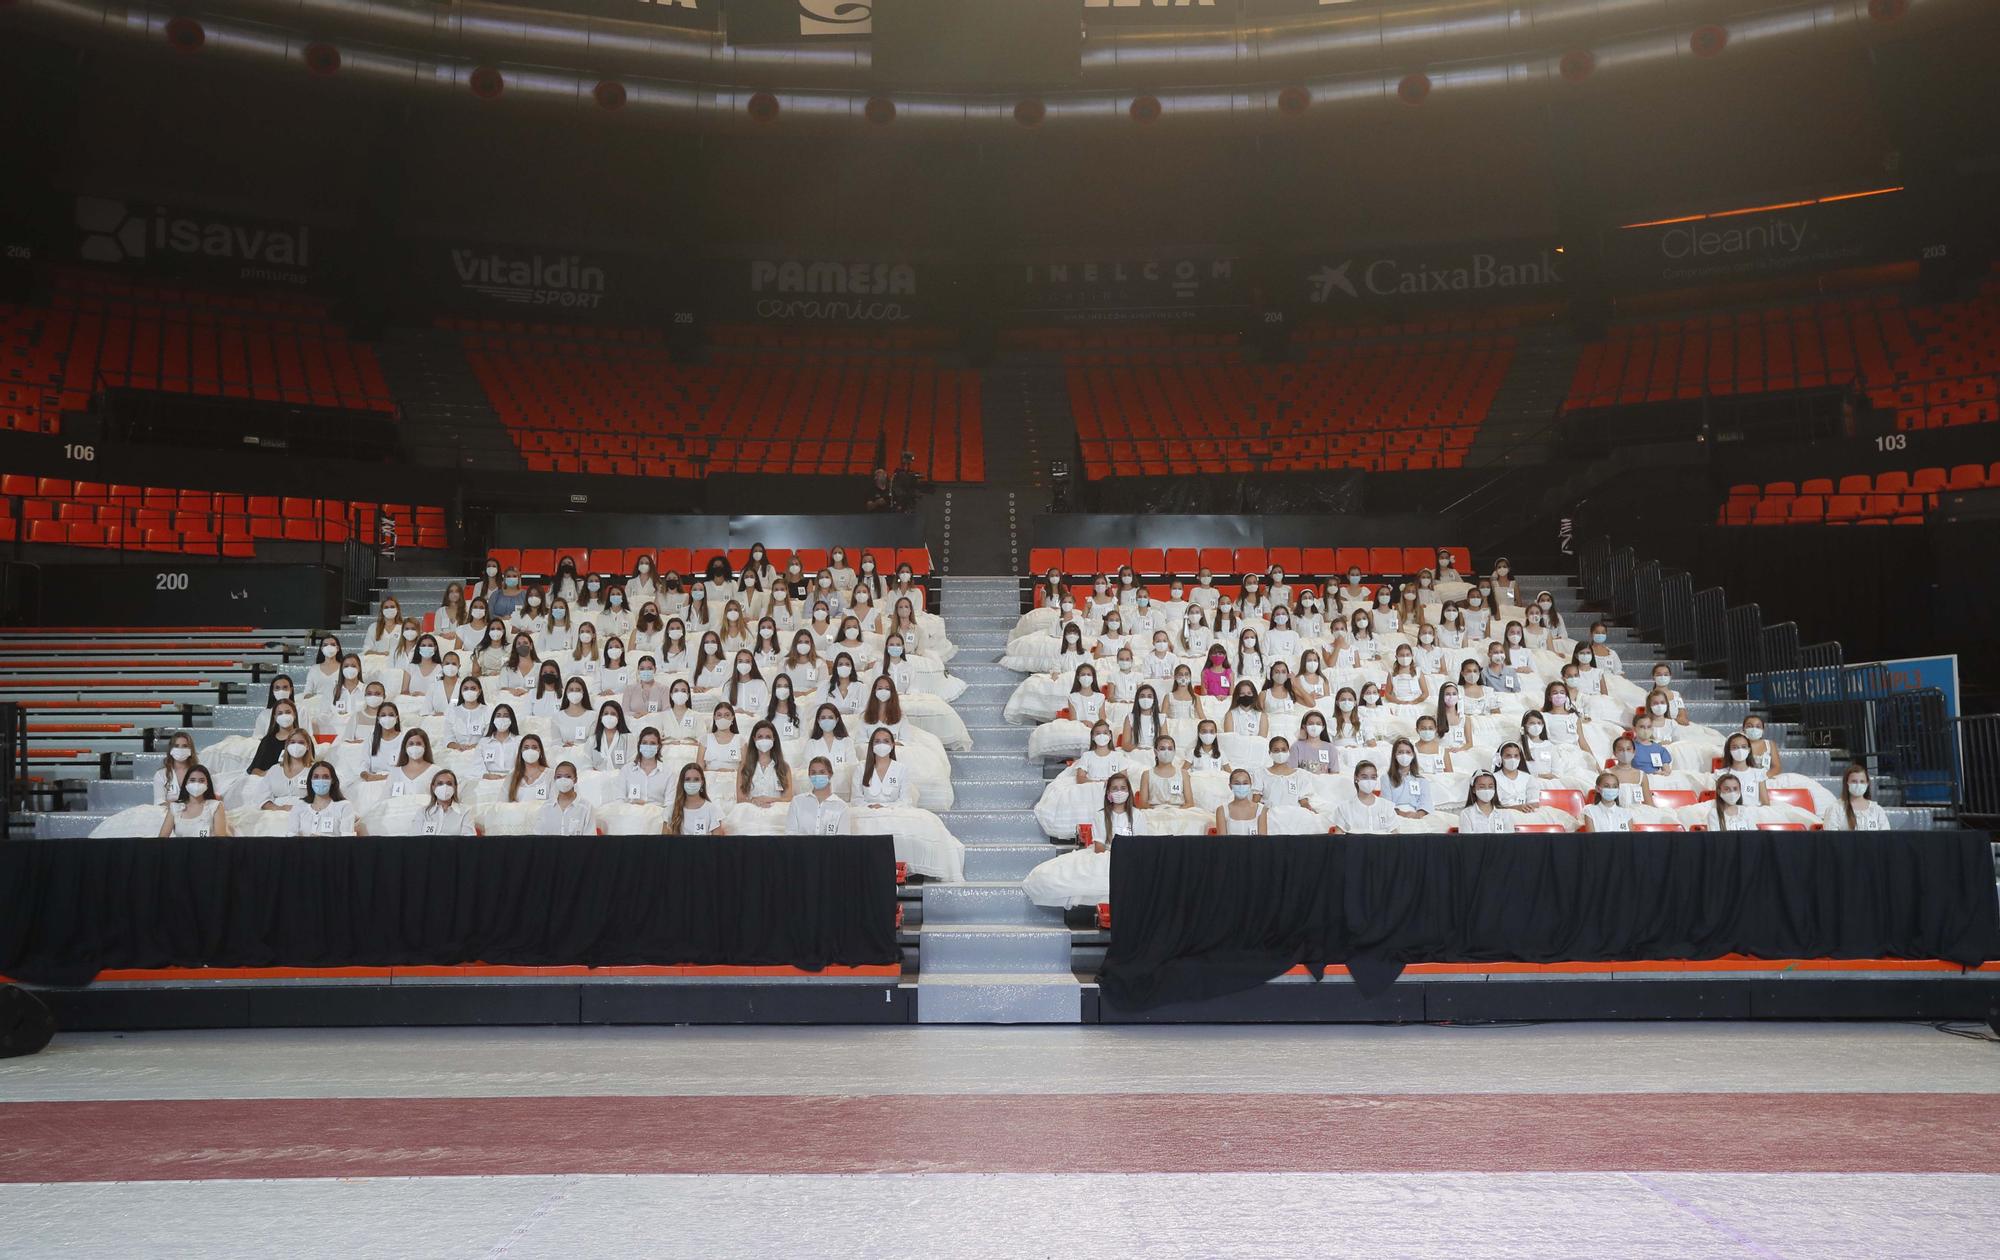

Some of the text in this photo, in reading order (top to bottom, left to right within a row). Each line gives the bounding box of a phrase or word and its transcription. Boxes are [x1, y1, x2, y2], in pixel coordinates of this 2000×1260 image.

[154, 203, 309, 267] isaval
[1662, 218, 1808, 258] Cleanity
[8, 245, 31, 258] 206
[1922, 244, 1946, 258] 203
[450, 248, 606, 292] Vitaldin
[751, 260, 916, 295] PAMESA
[1365, 249, 1563, 295] CaixaBank
[532, 289, 604, 309] SPORT
[673, 312, 694, 324] 205
[1264, 311, 1283, 323] 204
[1875, 434, 1906, 451] 103
[64, 443, 95, 461] 106
[156, 573, 188, 590] 200
[885, 989, 892, 1002] 1
